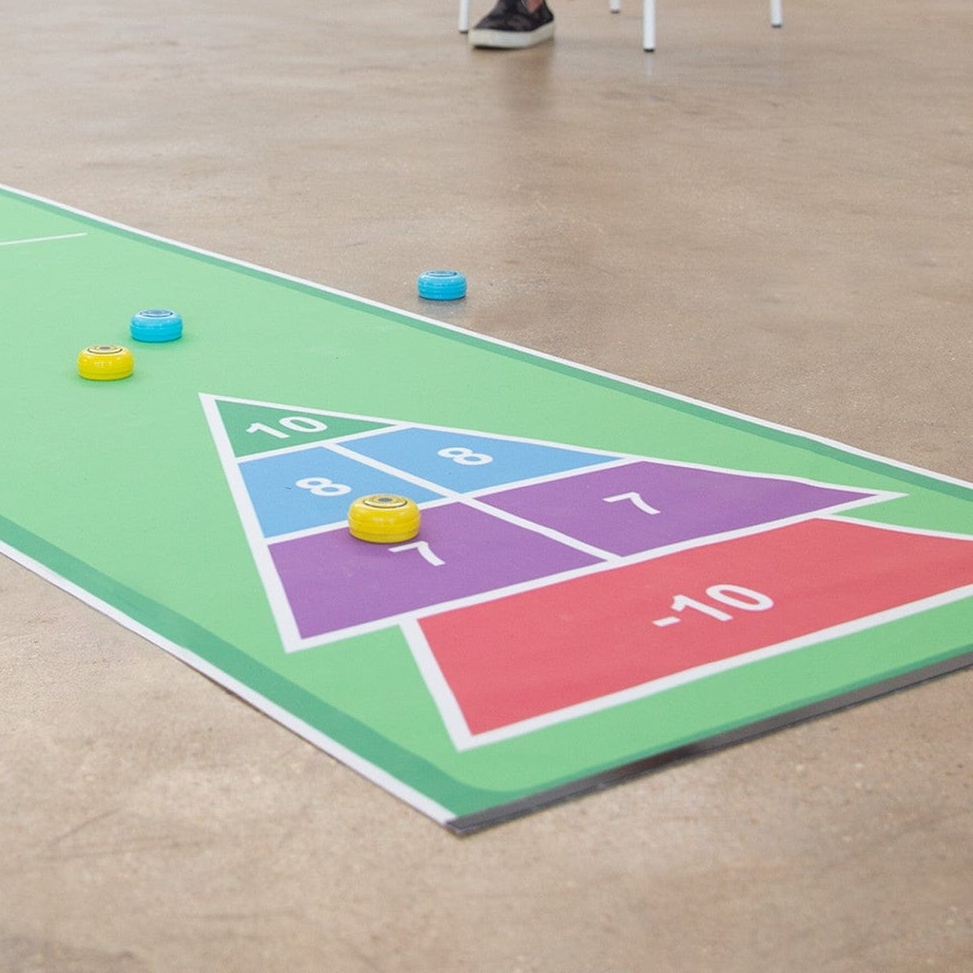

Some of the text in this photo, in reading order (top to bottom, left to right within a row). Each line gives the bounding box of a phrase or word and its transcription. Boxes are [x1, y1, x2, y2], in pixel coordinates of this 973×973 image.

[246, 416, 328, 439] 10
[437, 447, 494, 466] 8
[295, 477, 352, 497] 8
[602, 492, 661, 515] 7
[388, 541, 446, 567] 7
[652, 584, 775, 627] -10
